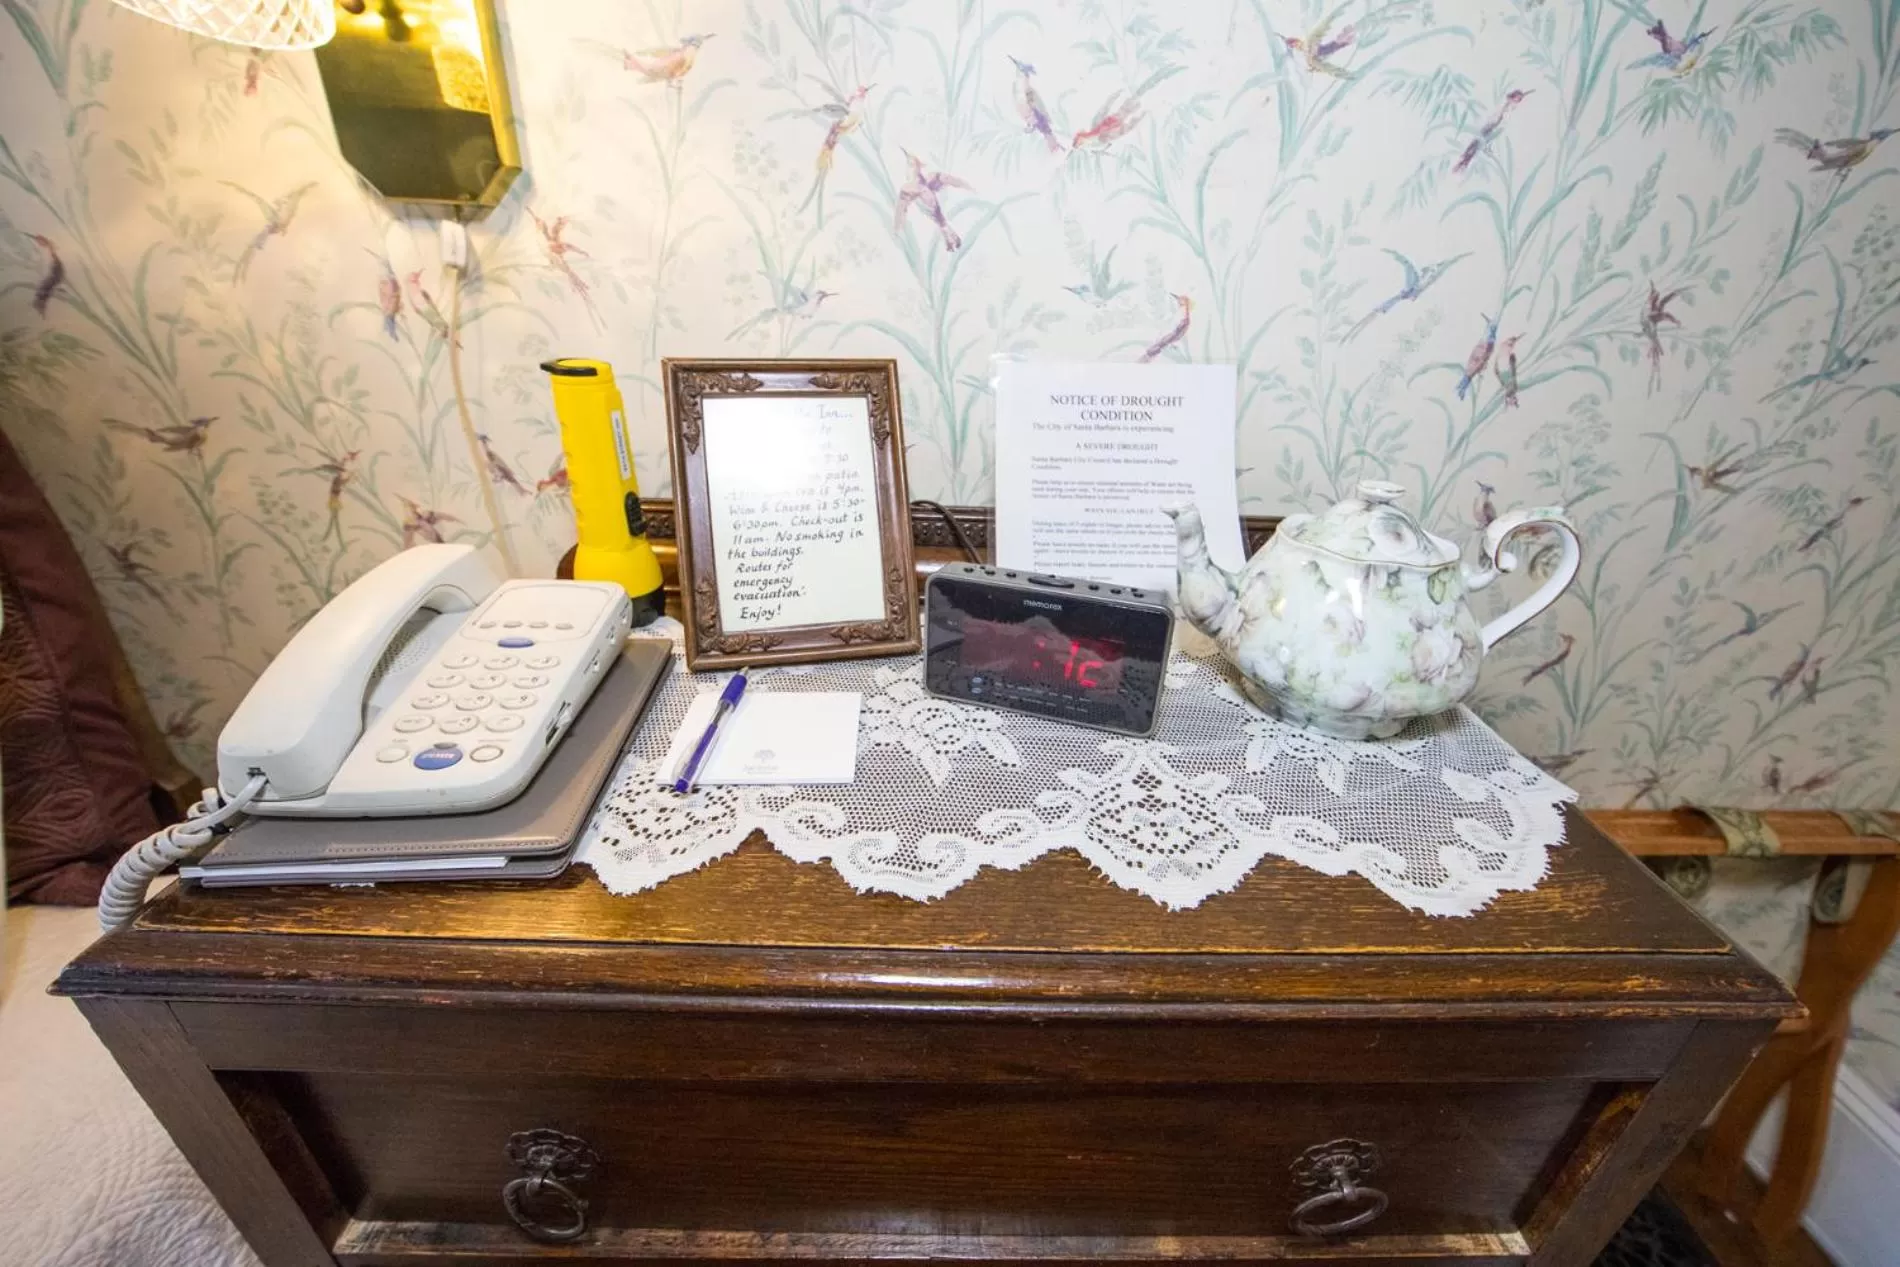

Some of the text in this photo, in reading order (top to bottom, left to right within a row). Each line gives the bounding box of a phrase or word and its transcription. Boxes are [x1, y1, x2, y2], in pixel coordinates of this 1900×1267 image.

[1050, 394, 1184, 407] NOTICE OF DROUGHT
[1080, 410, 1153, 421] CONDITION
[1117, 443, 1158, 451] DROUGHT
[774, 502, 811, 514] Cheese
[817, 500, 827, 511] is
[790, 513, 848, 527] Check-out
[854, 513, 864, 523] is
[794, 530, 844, 544] smoking
[850, 528, 864, 539] in
[727, 546, 804, 561] the buildings.
[735, 562, 794, 573] Routes for
[733, 576, 794, 591] emergency
[1023, 599, 1062, 611] memorex
[740, 603, 781, 623] Enjoy!
